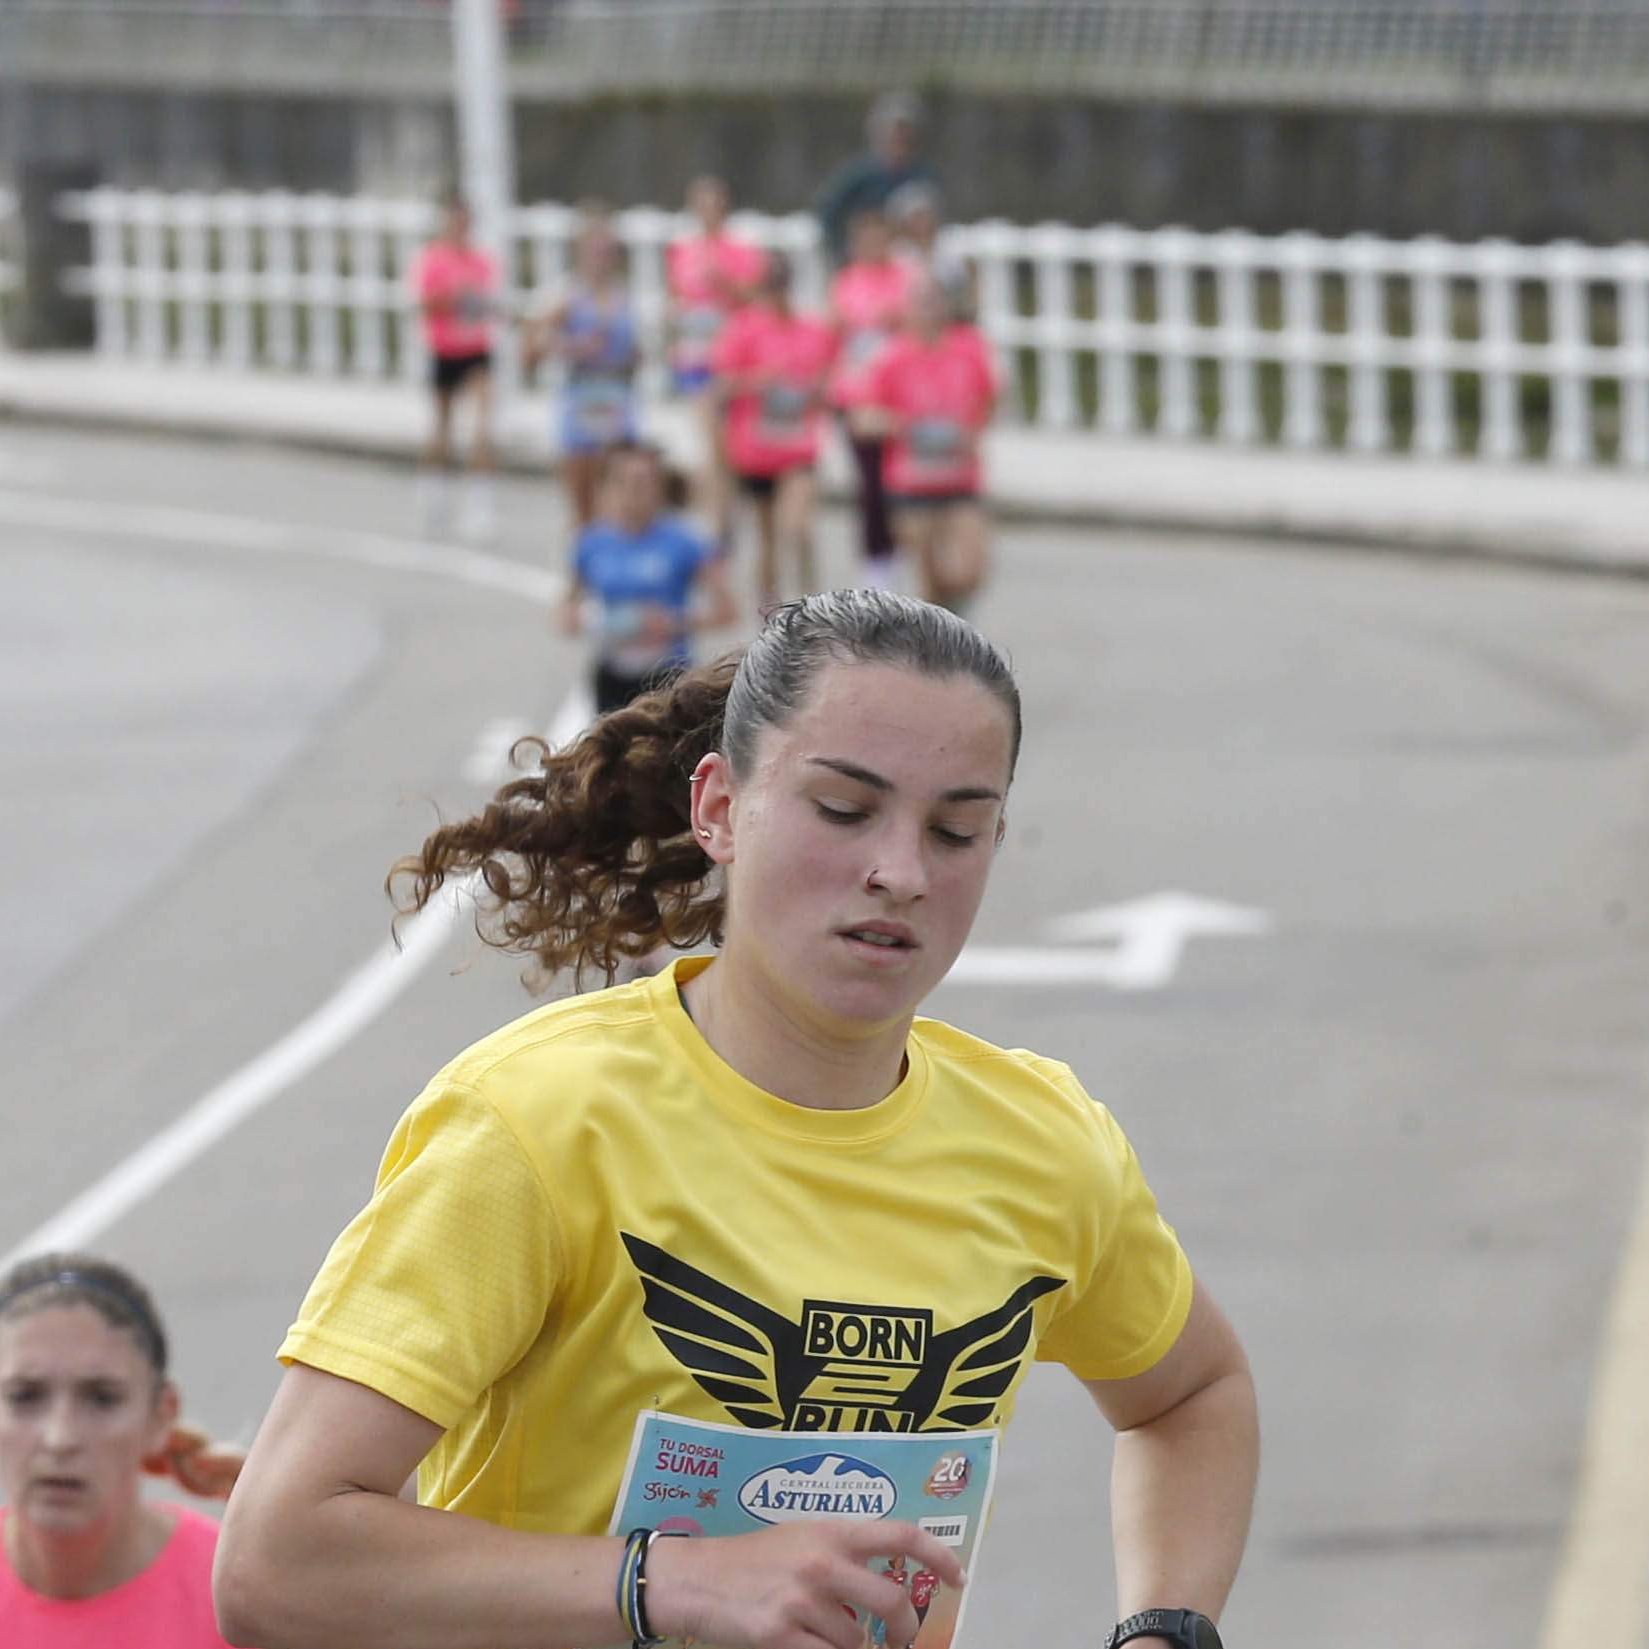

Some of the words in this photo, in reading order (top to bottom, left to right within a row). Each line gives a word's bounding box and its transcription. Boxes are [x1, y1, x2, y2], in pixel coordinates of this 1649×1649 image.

[808, 1312, 923, 1362] BORN
[799, 1362, 921, 1406] 2
[659, 1437, 676, 1451] TU
[678, 1441, 727, 1460] DORSAL
[655, 1451, 720, 1479] SUMA
[934, 1455, 967, 1481] 20
[747, 1479, 885, 1514] ASTURIANA
[779, 1478, 830, 1489] CENTRAL
